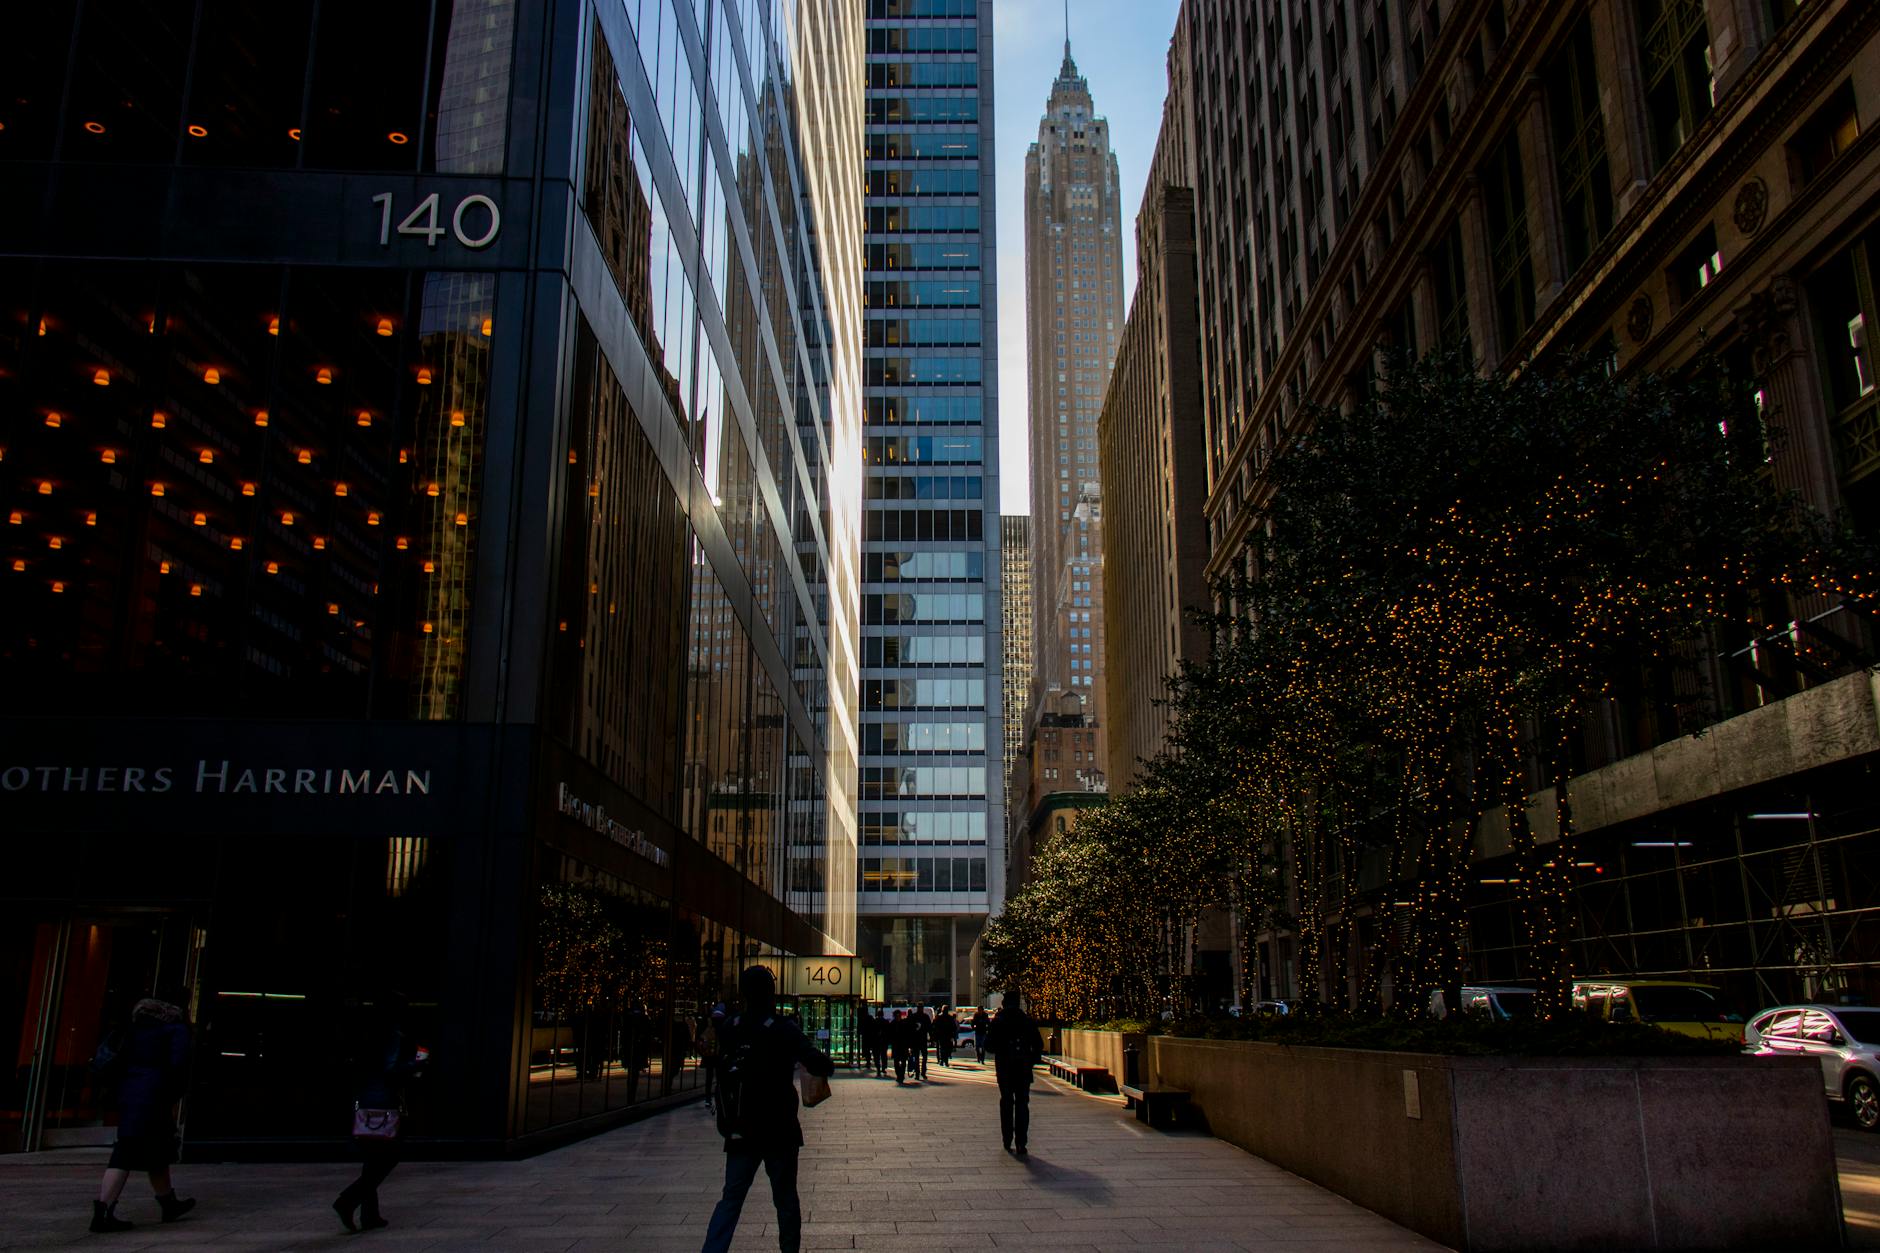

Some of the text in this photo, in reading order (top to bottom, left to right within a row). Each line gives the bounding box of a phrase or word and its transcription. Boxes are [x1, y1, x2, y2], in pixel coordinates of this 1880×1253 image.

[372, 192, 500, 248] 140
[1, 760, 430, 794] OTHERS HARRIMAN
[805, 966, 842, 985] 140
